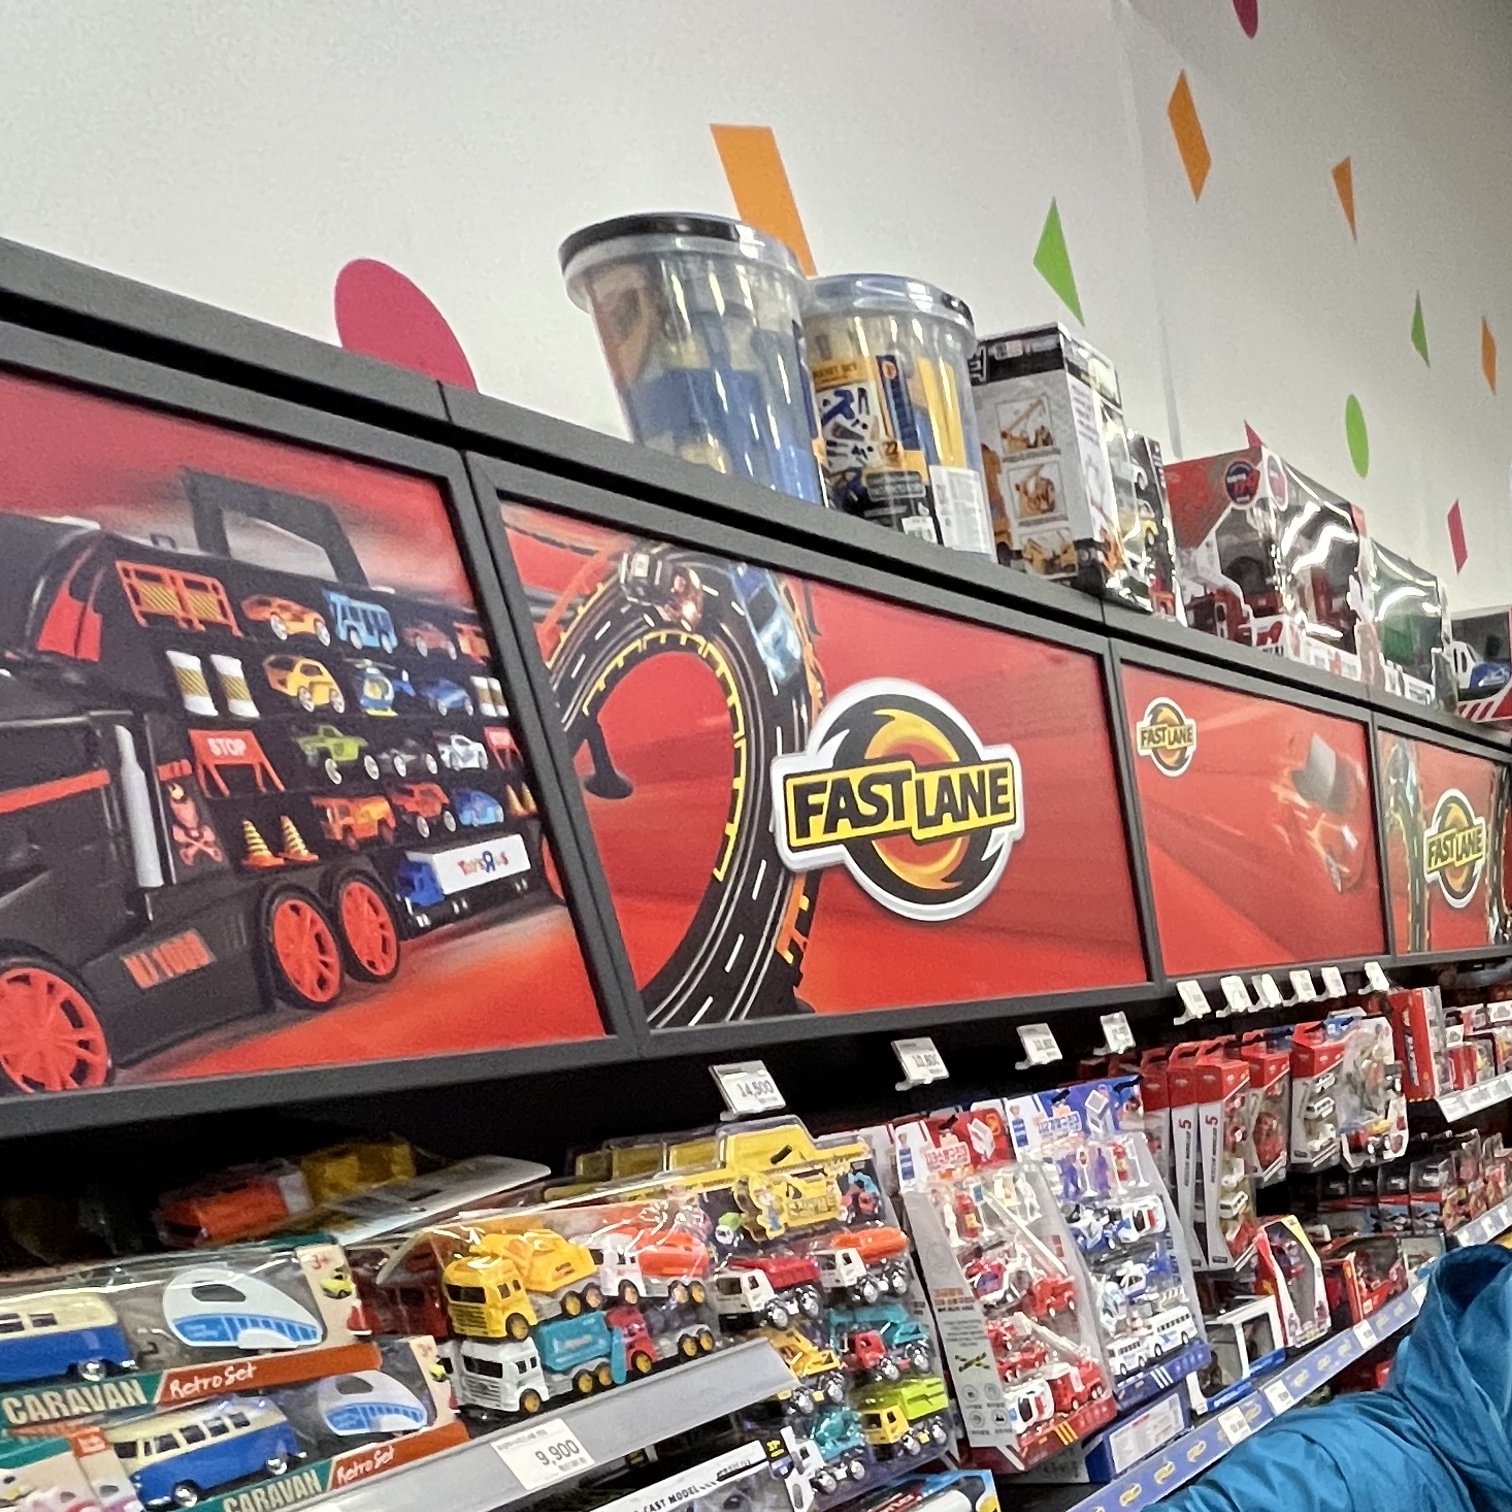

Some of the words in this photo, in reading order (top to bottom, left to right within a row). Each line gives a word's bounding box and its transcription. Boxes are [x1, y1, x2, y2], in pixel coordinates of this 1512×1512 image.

[207, 735, 247, 758] STOP
[793, 769, 914, 838] FAST
[916, 765, 1011, 827] LANE
[2, 1378, 147, 1426] CARAVAN
[534, 1440, 580, 1467] 9,900
[668, 1485, 700, 1505] MODEL
